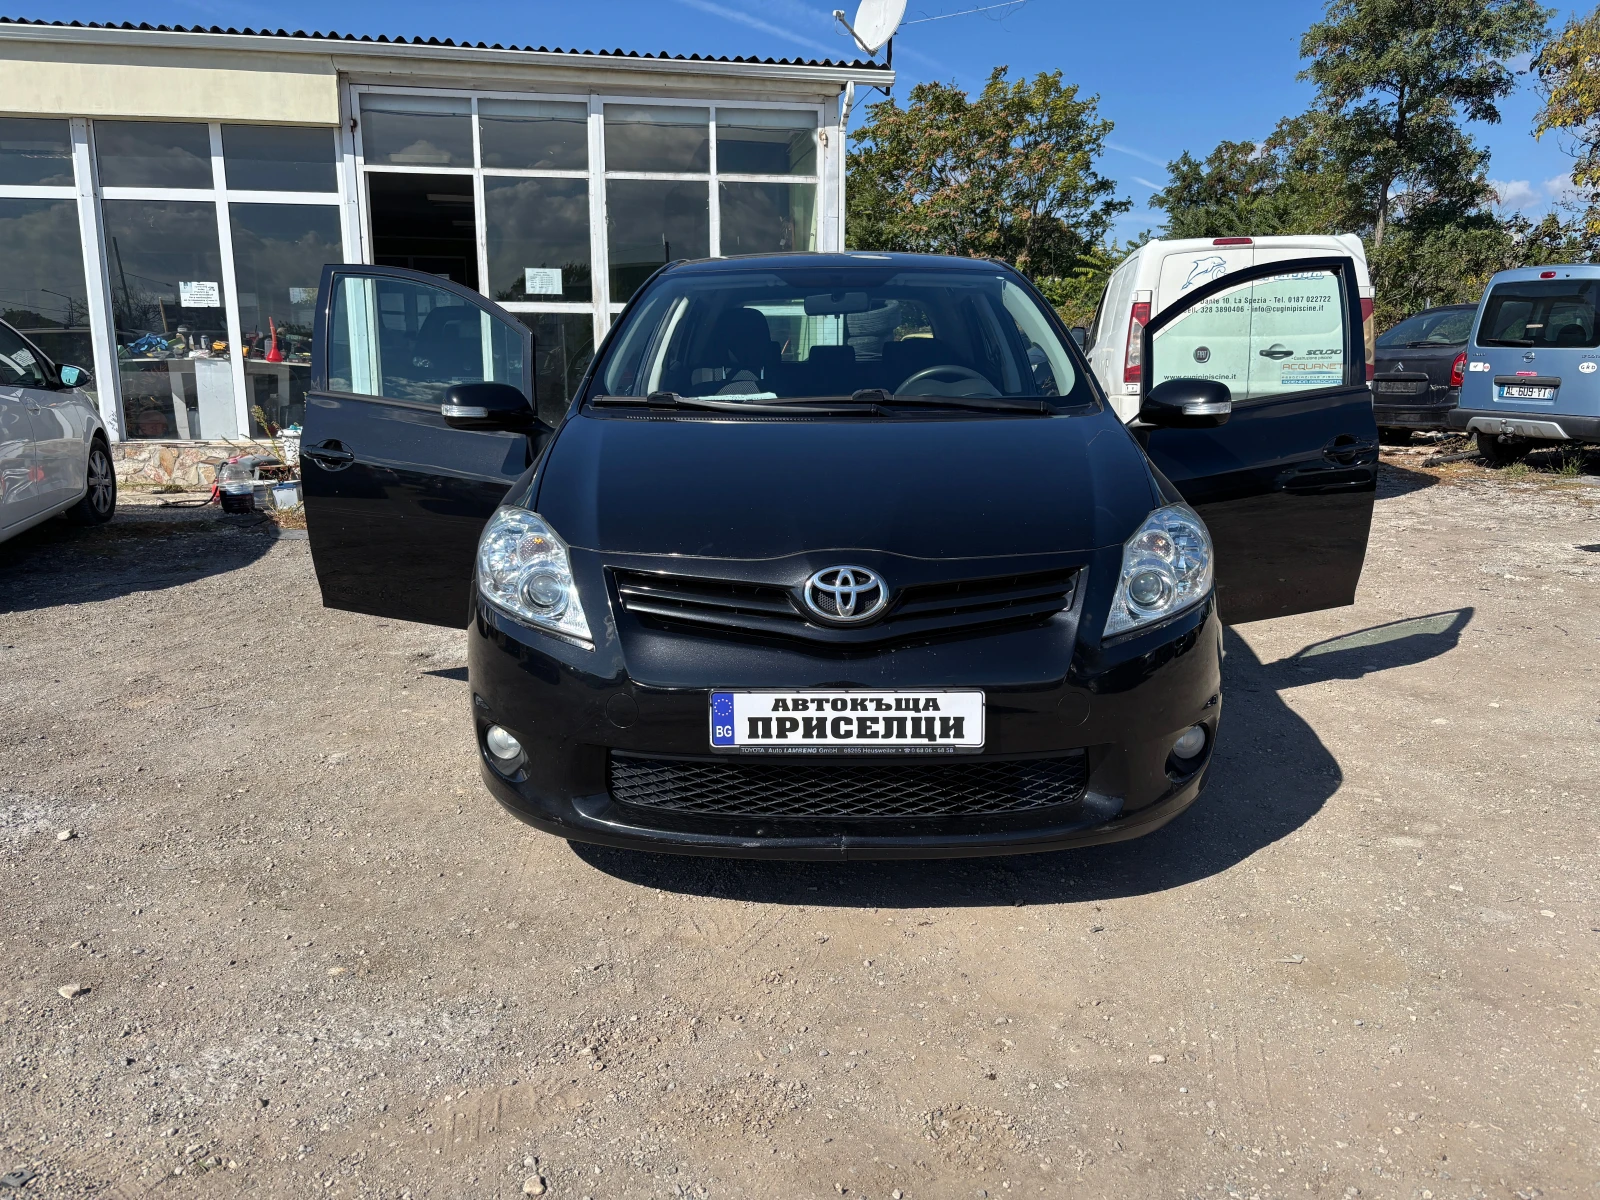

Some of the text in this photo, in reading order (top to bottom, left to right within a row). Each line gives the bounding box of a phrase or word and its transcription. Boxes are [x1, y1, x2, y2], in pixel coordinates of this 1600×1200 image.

[1244, 296, 1266, 304] Spezia
[1252, 305, 1324, 313] info@cuginipiscine.it
[771, 698, 941, 713] АВТОКЪЩА
[716, 726, 732, 738] BG
[748, 716, 965, 742] ПРИСЕЛЦИ
